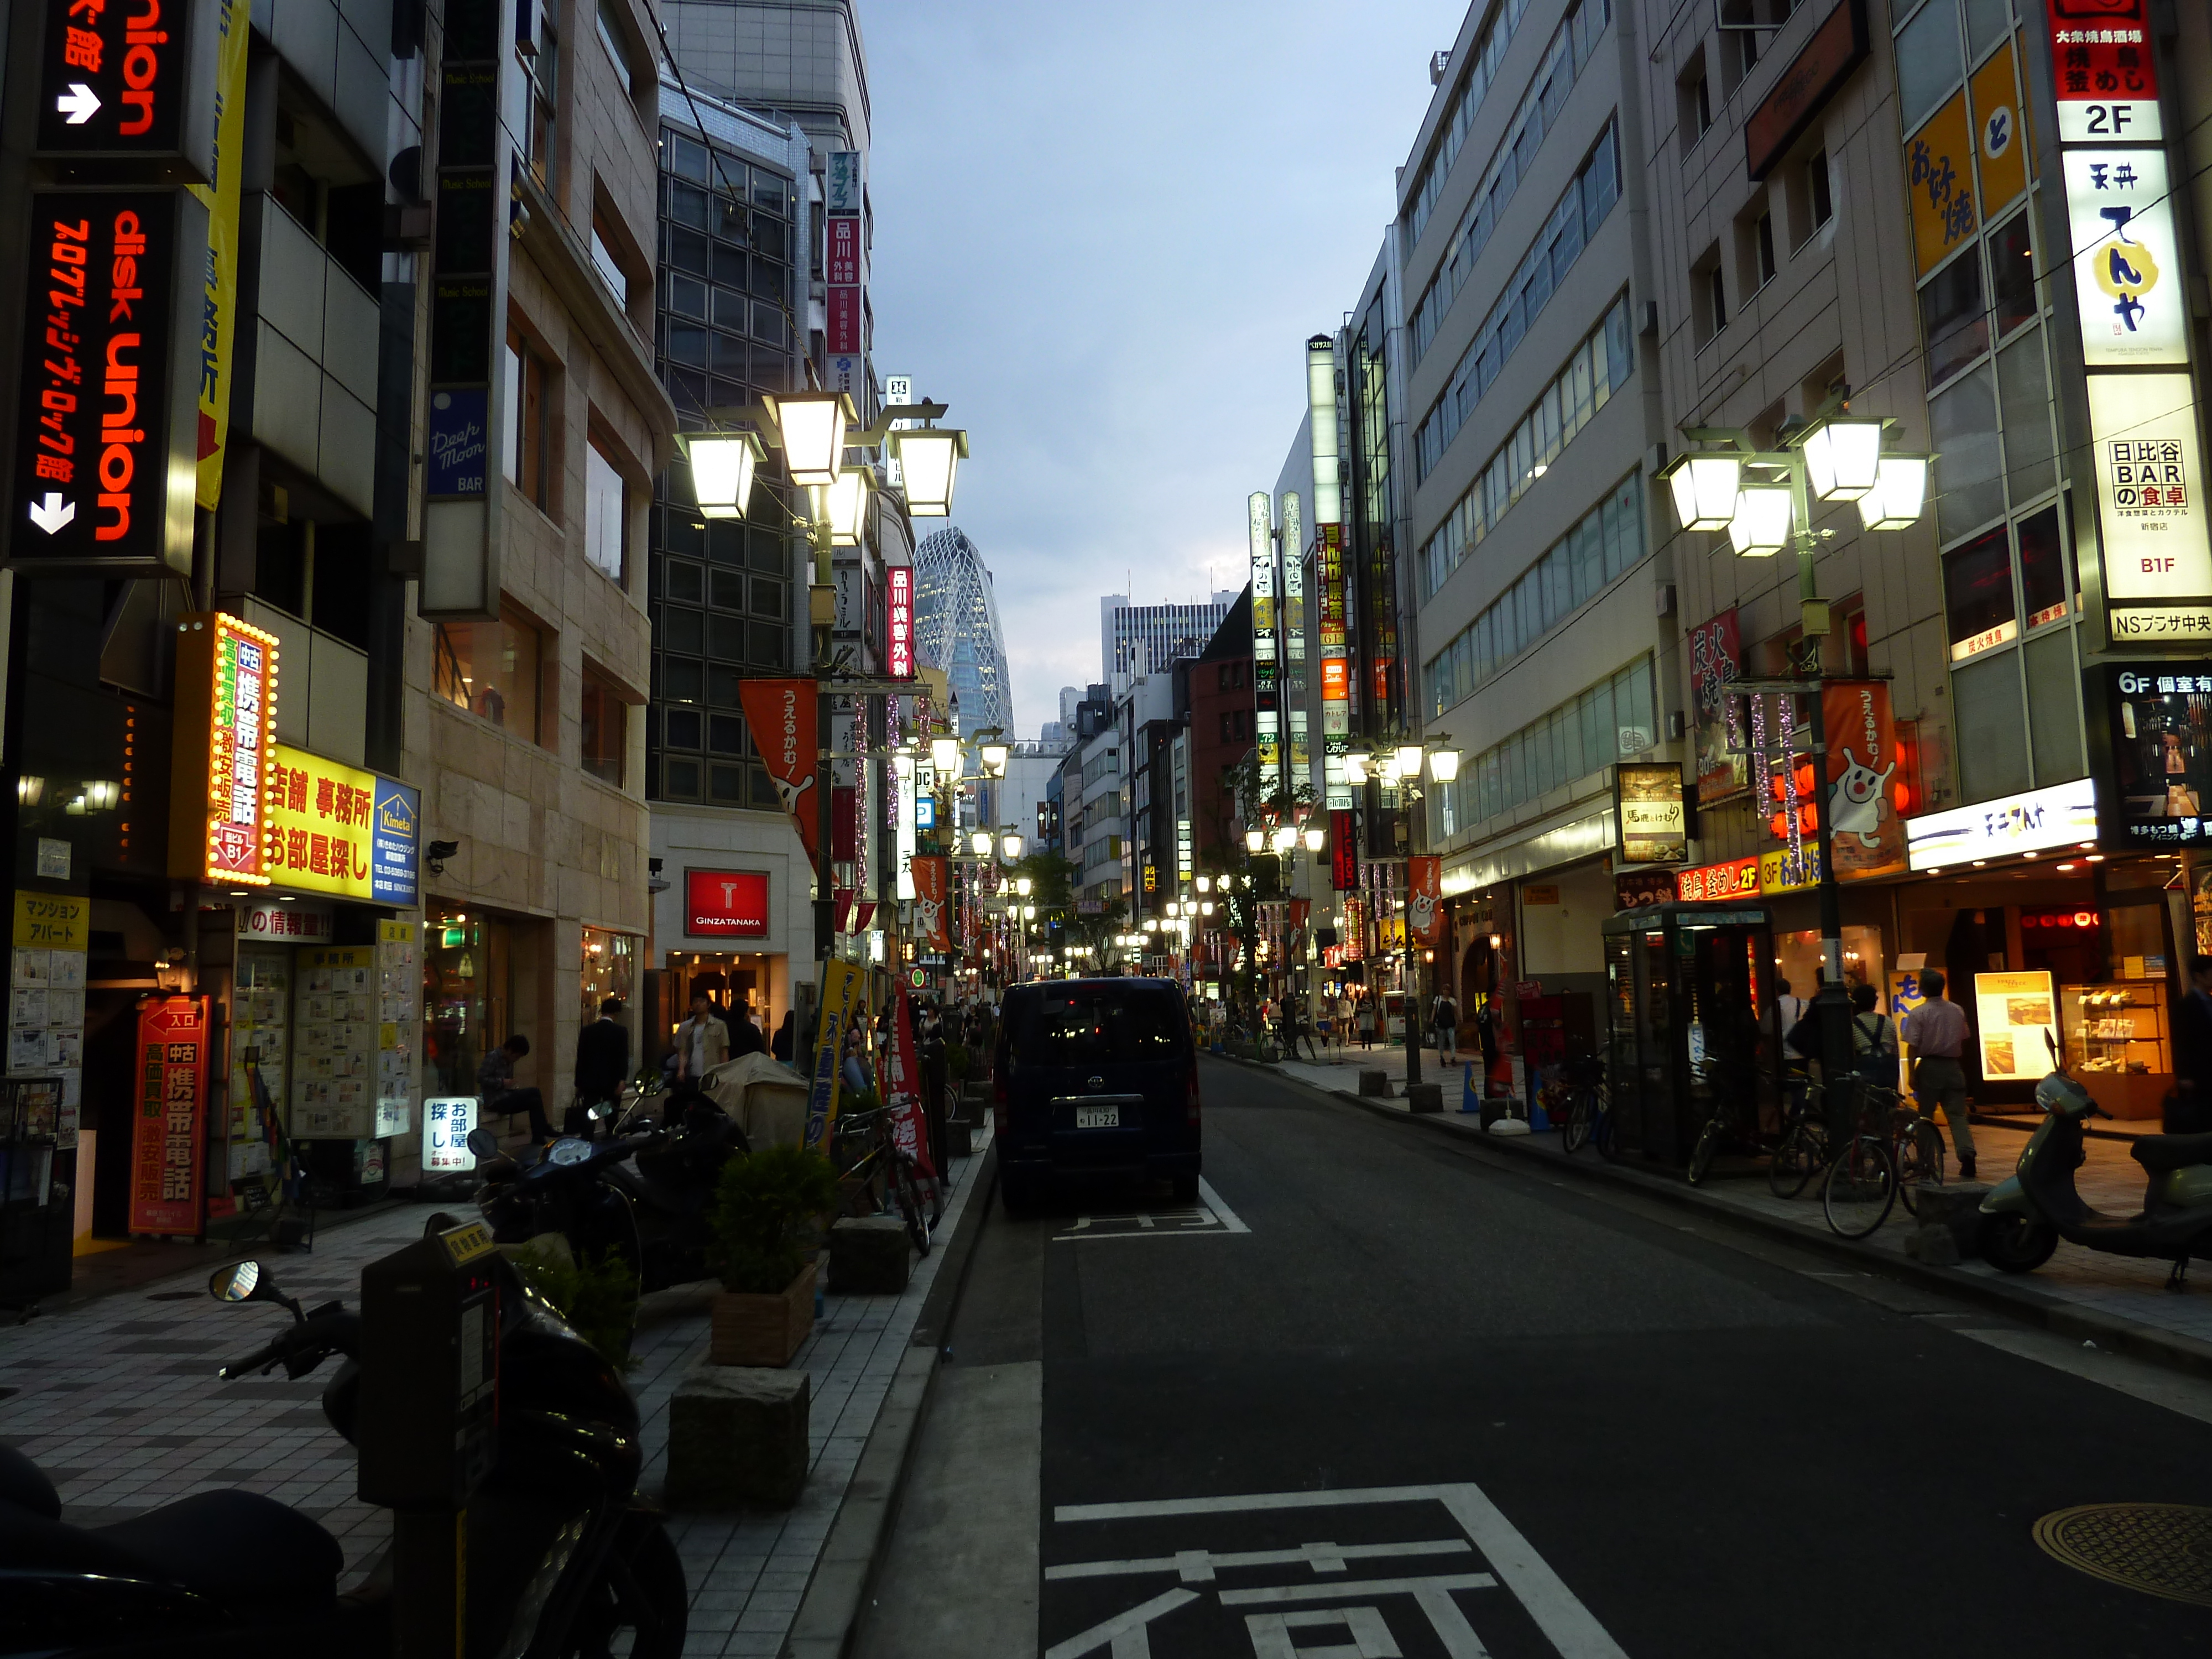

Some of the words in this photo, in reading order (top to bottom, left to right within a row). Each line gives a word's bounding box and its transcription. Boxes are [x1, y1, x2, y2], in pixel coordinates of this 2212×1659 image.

[2056, 30, 2142, 44] 大衆焼鳥酒場
[446, 73, 466, 84] Music
[469, 73, 494, 84] School
[2065, 70, 2144, 93] 釜めし
[1990, 114, 2007, 150] と
[2084, 105, 2131, 134] 2F
[442, 179, 463, 190] Music
[466, 179, 491, 189] School
[2089, 160, 2138, 190] 天丼
[836, 222, 851, 258] 品川
[109, 210, 147, 325] disk
[834, 261, 842, 282] 外科
[2099, 206, 2145, 332] てんや
[439, 286, 459, 298] Music
[462, 286, 488, 297] School
[839, 290, 848, 351] 品川美容外科
[35, 219, 90, 483] プログレッシヴ・ロック館
[95, 333, 146, 541] union
[432, 421, 480, 455] Deep
[439, 444, 486, 470] Moon
[2114, 442, 2179, 461] 日比谷
[458, 477, 483, 492] BAR
[2117, 465, 2181, 484] BAR
[2117, 486, 2185, 506] の食卓
[2117, 509, 2188, 518] 洋食惣菜とカクテル
[2141, 523, 2168, 531] 新宿店
[1326, 525, 1343, 620] まんが喫茶
[2141, 559, 2174, 573] B1F
[893, 571, 908, 677] 品川美容外科
[1325, 635, 1341, 644] 6F
[1693, 622, 1726, 675] 炭火
[1968, 629, 2002, 654] 炭火焼鳥
[240, 644, 260, 670] 中古
[220, 635, 238, 728] 高価買取
[2119, 672, 2150, 693] 6F
[782, 689, 797, 779] うえるかむ!
[1859, 690, 1879, 769] うえるかむ!
[233, 670, 260, 826] 携帯電話
[215, 729, 234, 824] 激安販売
[270, 762, 309, 815] 店舗
[316, 777, 372, 830] 事務所
[384, 810, 410, 831] Kimeta
[2012, 802, 2045, 832] てんや
[2129, 824, 2178, 835] 博多もつ鍋
[225, 831, 245, 847] 当ビル
[268, 823, 368, 880] お部屋探し
[227, 845, 242, 860] B1
[1345, 838, 1354, 886] union
[1681, 874, 1704, 901] 焼鳥
[1707, 865, 1738, 898] 釜めし
[1741, 867, 1756, 889] 2F
[1764, 862, 1777, 884] 3F
[27, 899, 80, 921] マンション
[30, 924, 73, 942] アパート
[314, 952, 354, 965] 事務所
[170, 1013, 194, 1027] 入口
[170, 1044, 196, 1062] 中古
[142, 1042, 164, 1120] 高価買取
[431, 1103, 448, 1148] 探し
[450, 1103, 467, 1148] お部屋
[1087, 1113, 1117, 1126] 11-22
[163, 1066, 196, 1202] 携帯電話
[139, 1124, 161, 1202] 激安販売
[431, 1156, 466, 1167] 募集中!
